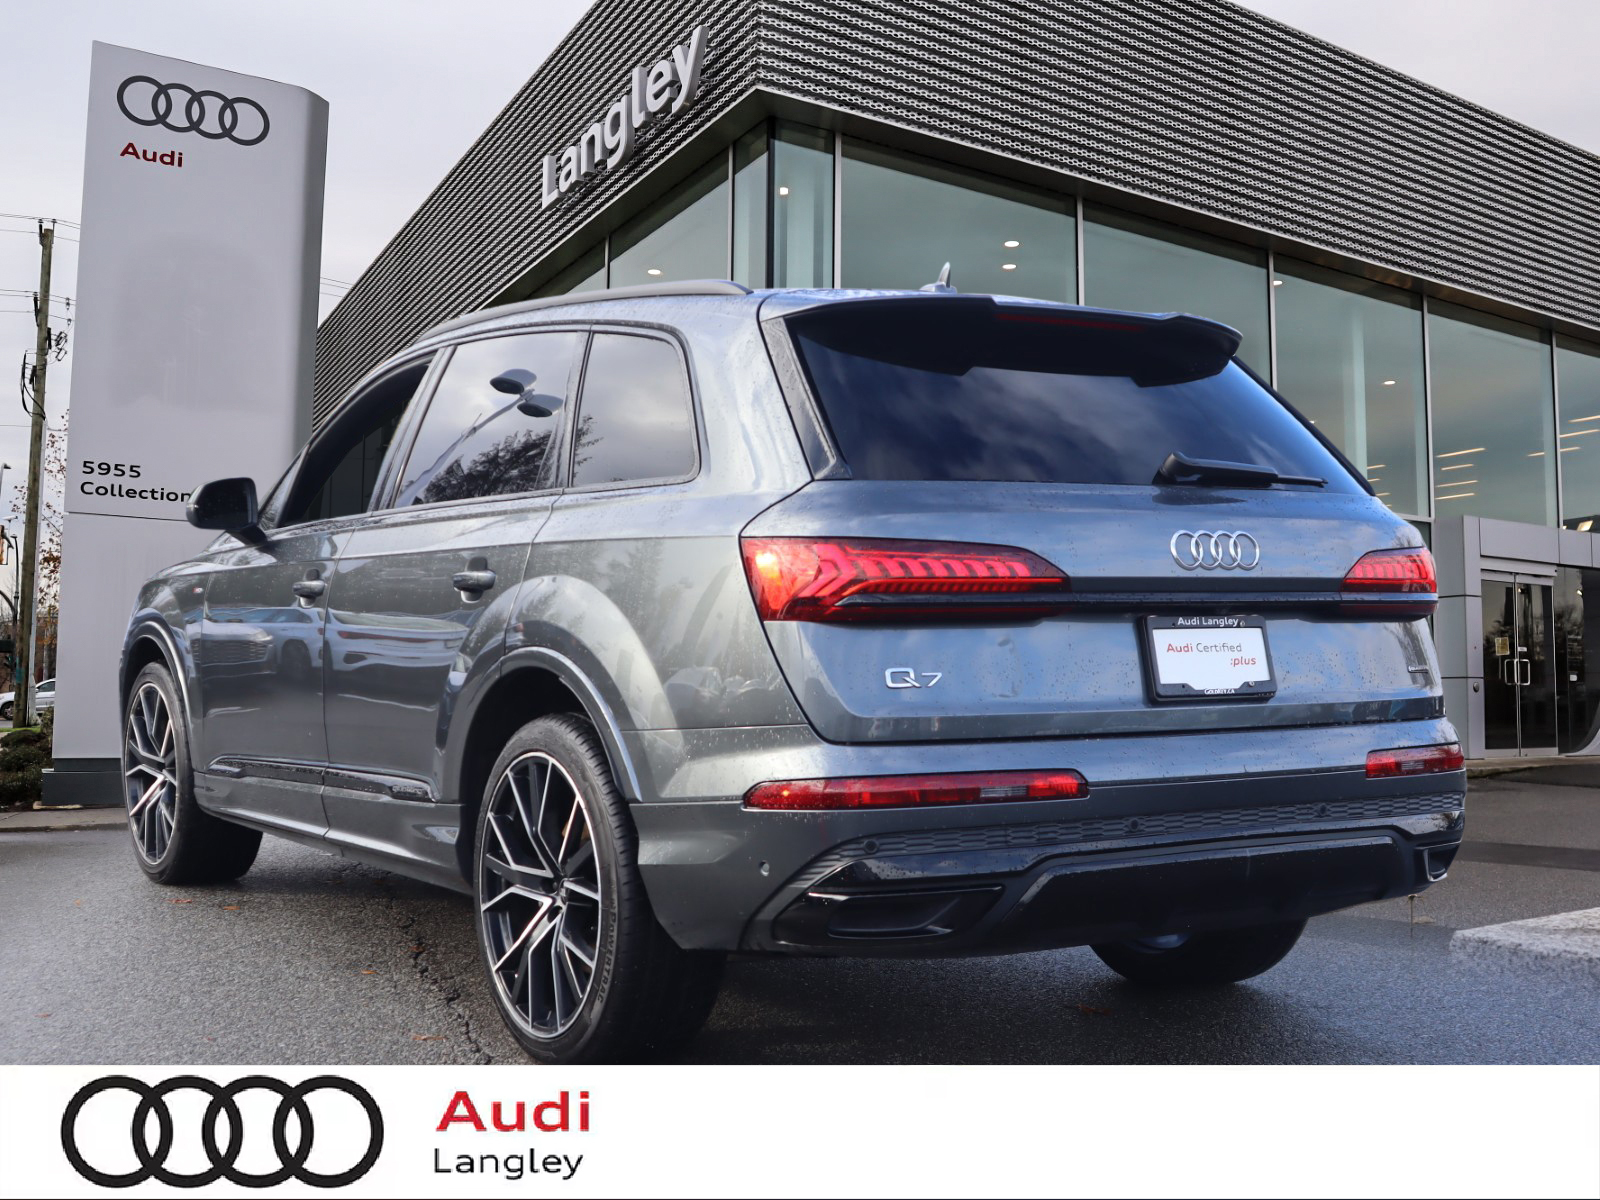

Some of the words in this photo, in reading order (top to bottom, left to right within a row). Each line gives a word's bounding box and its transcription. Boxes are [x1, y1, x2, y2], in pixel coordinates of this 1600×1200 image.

[542, 25, 710, 209] Langley
[120, 142, 183, 167] Audi
[82, 460, 141, 478] 5955
[80, 481, 191, 502] Collection
[1177, 617, 1200, 626] Audi
[1202, 617, 1239, 627] Langley
[1166, 643, 1193, 652] Audi
[1195, 642, 1242, 652] Certified
[885, 667, 943, 689] Q7
